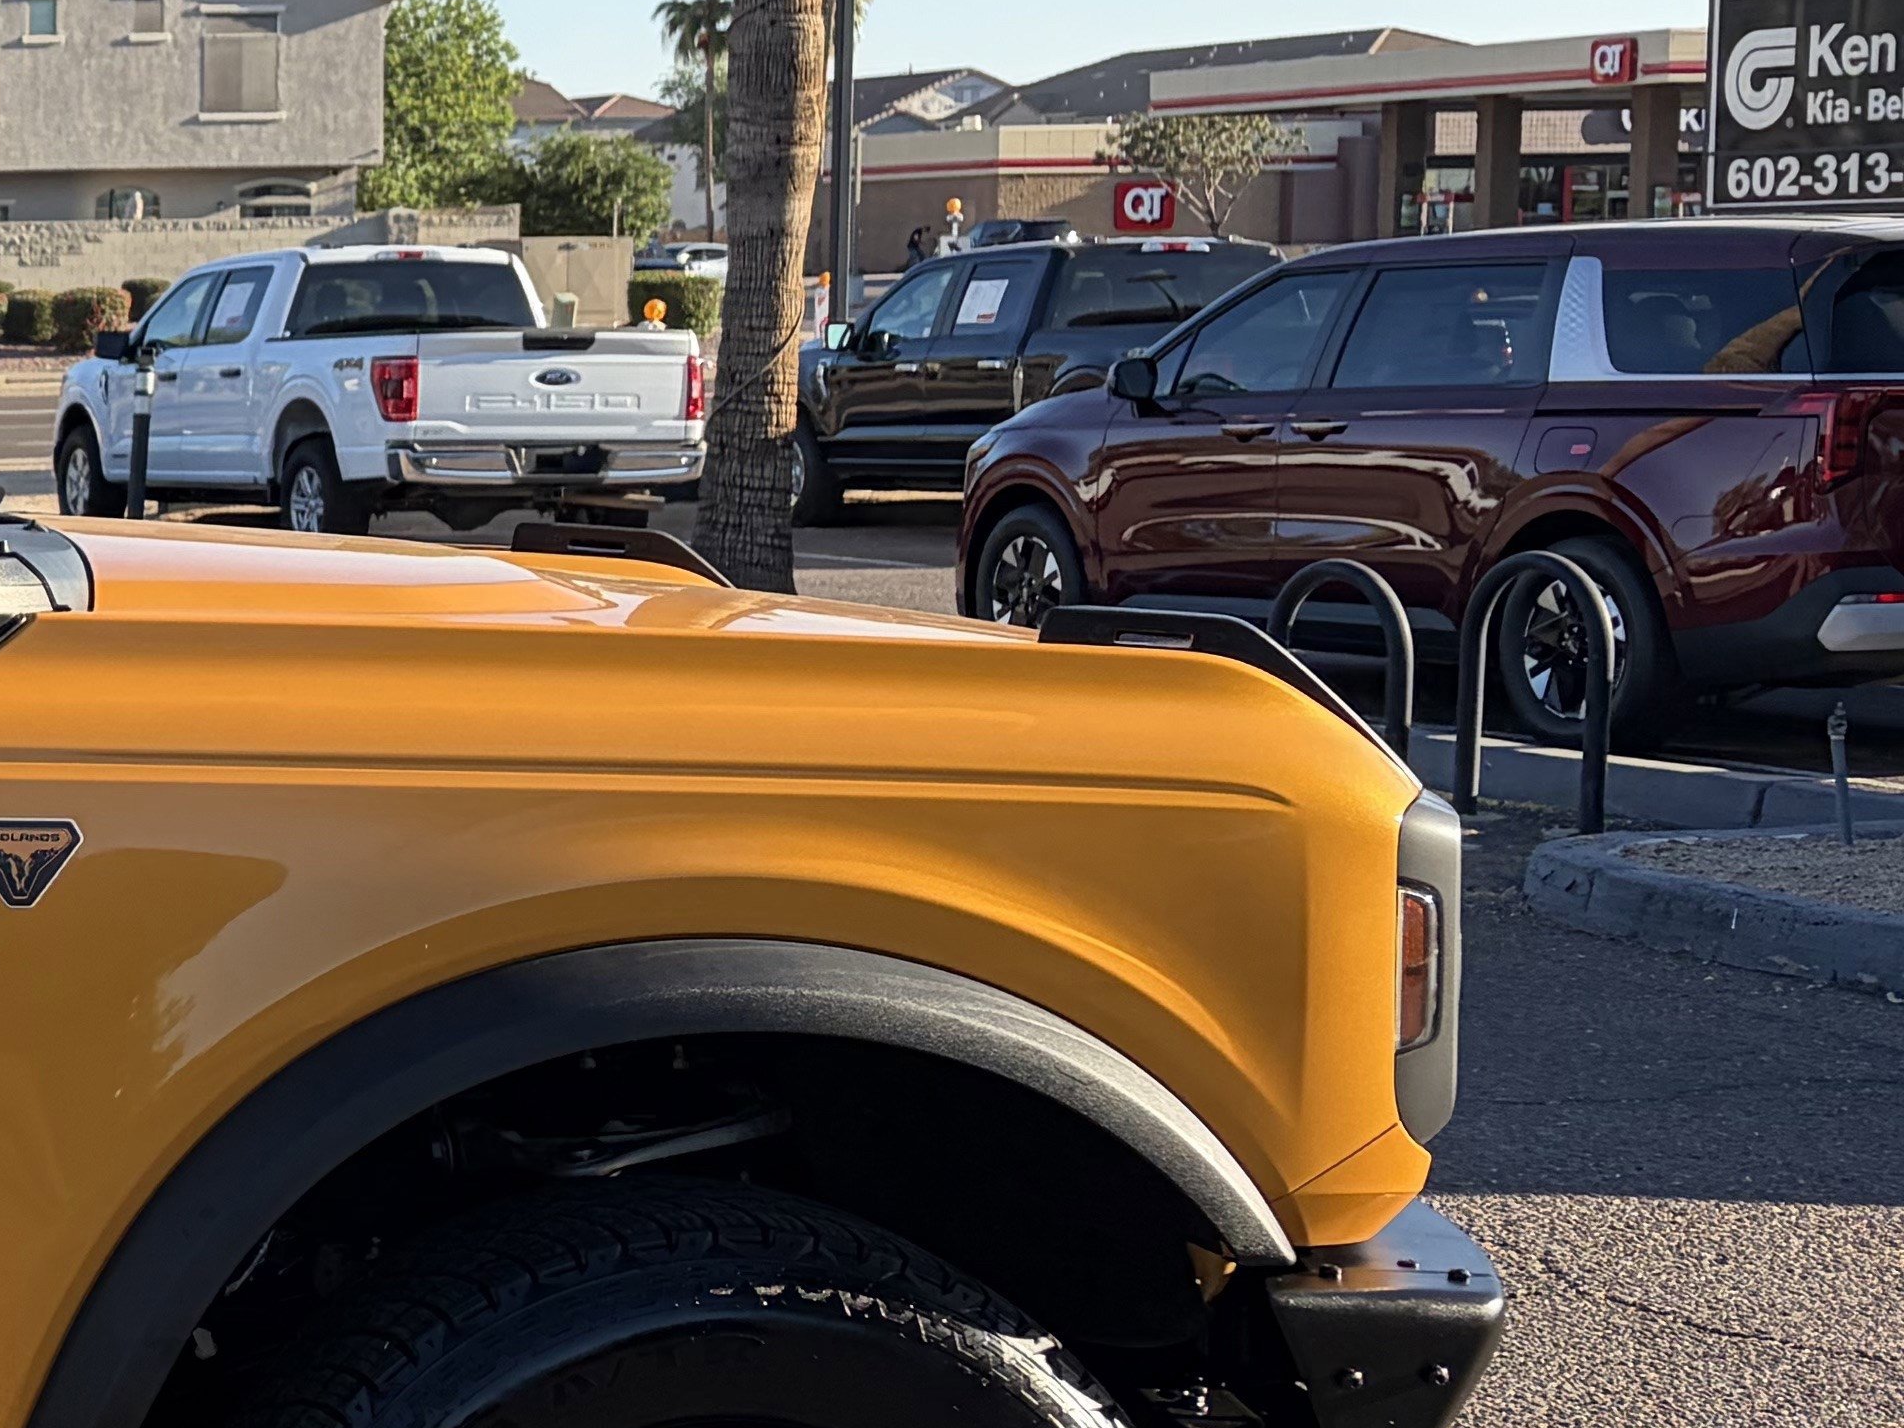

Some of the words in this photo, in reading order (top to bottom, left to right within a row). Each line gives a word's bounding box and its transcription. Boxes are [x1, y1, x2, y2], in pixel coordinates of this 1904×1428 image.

[1594, 44, 1624, 76] QT
[1808, 23, 1896, 77] Ken
[1806, 89, 1850, 125] Kia
[1867, 87, 1904, 121] Be
[1124, 187, 1167, 223] QT
[465, 393, 640, 413] F-150
